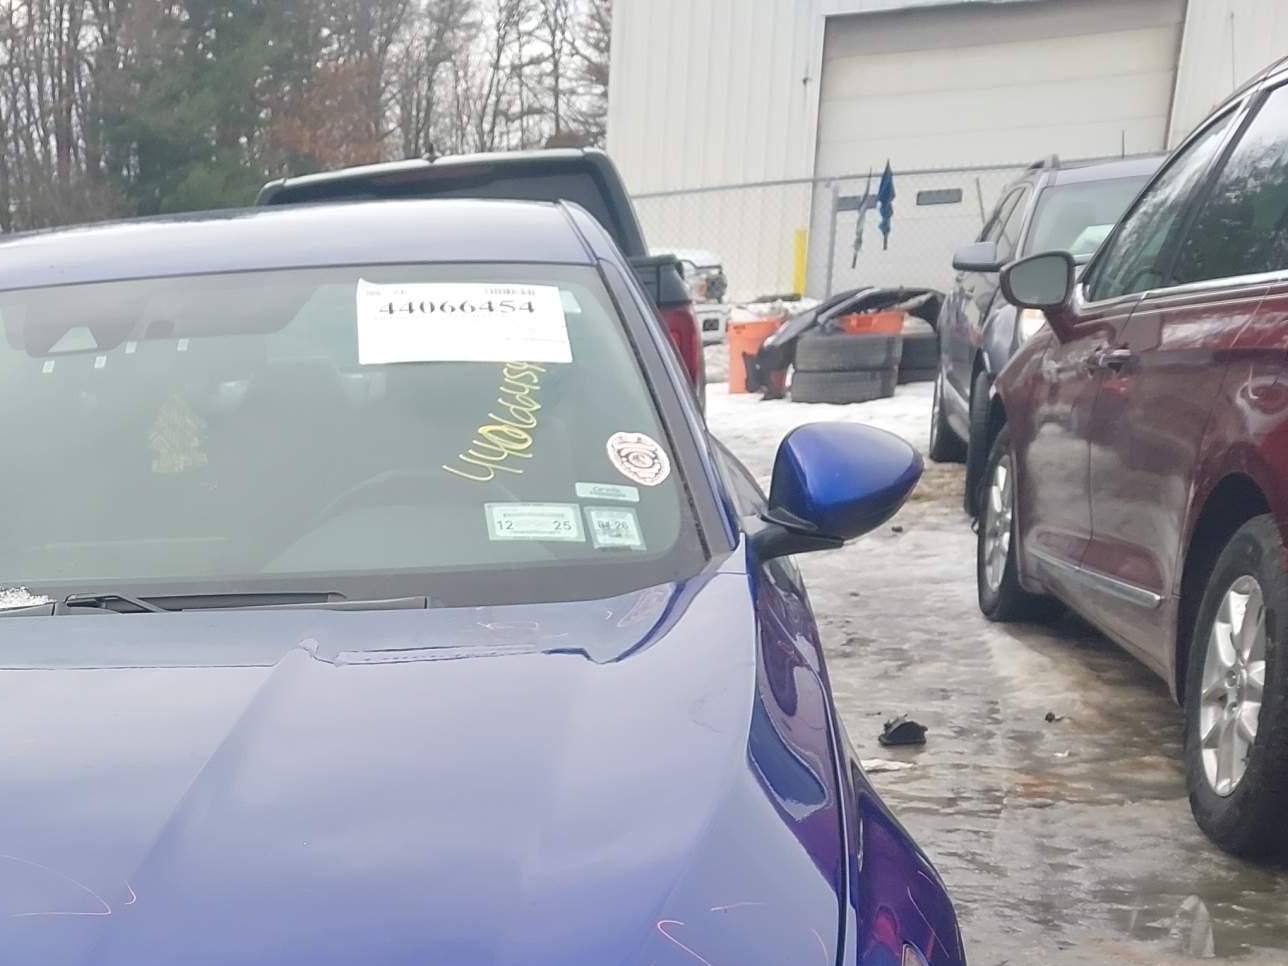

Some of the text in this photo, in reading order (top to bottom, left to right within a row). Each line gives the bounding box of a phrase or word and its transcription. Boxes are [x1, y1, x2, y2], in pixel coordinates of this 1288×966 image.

[379, 300, 535, 315] 44066454
[496, 520, 572, 531] 12 25
